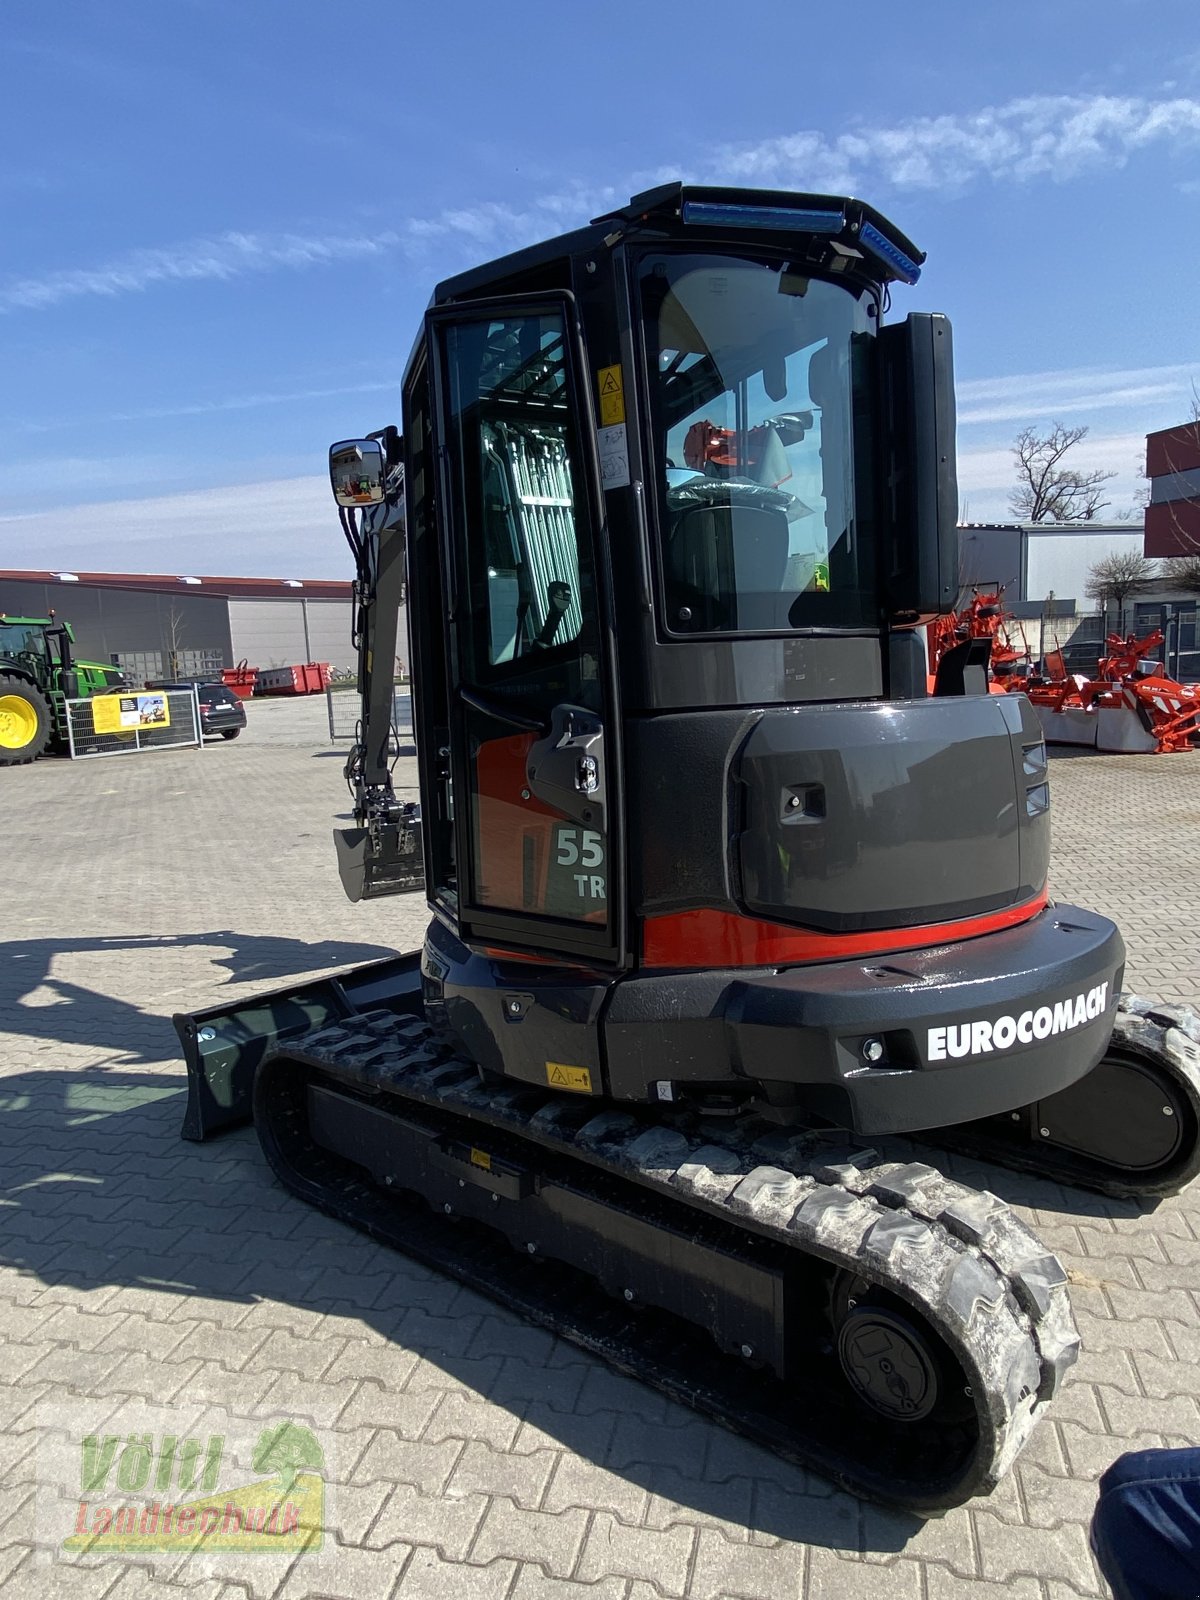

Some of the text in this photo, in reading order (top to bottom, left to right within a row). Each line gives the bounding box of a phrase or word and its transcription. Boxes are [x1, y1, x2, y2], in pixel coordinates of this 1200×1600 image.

[557, 829, 604, 867] 55
[573, 874, 606, 899] TR
[927, 982, 1107, 1061] EUROCOMACH
